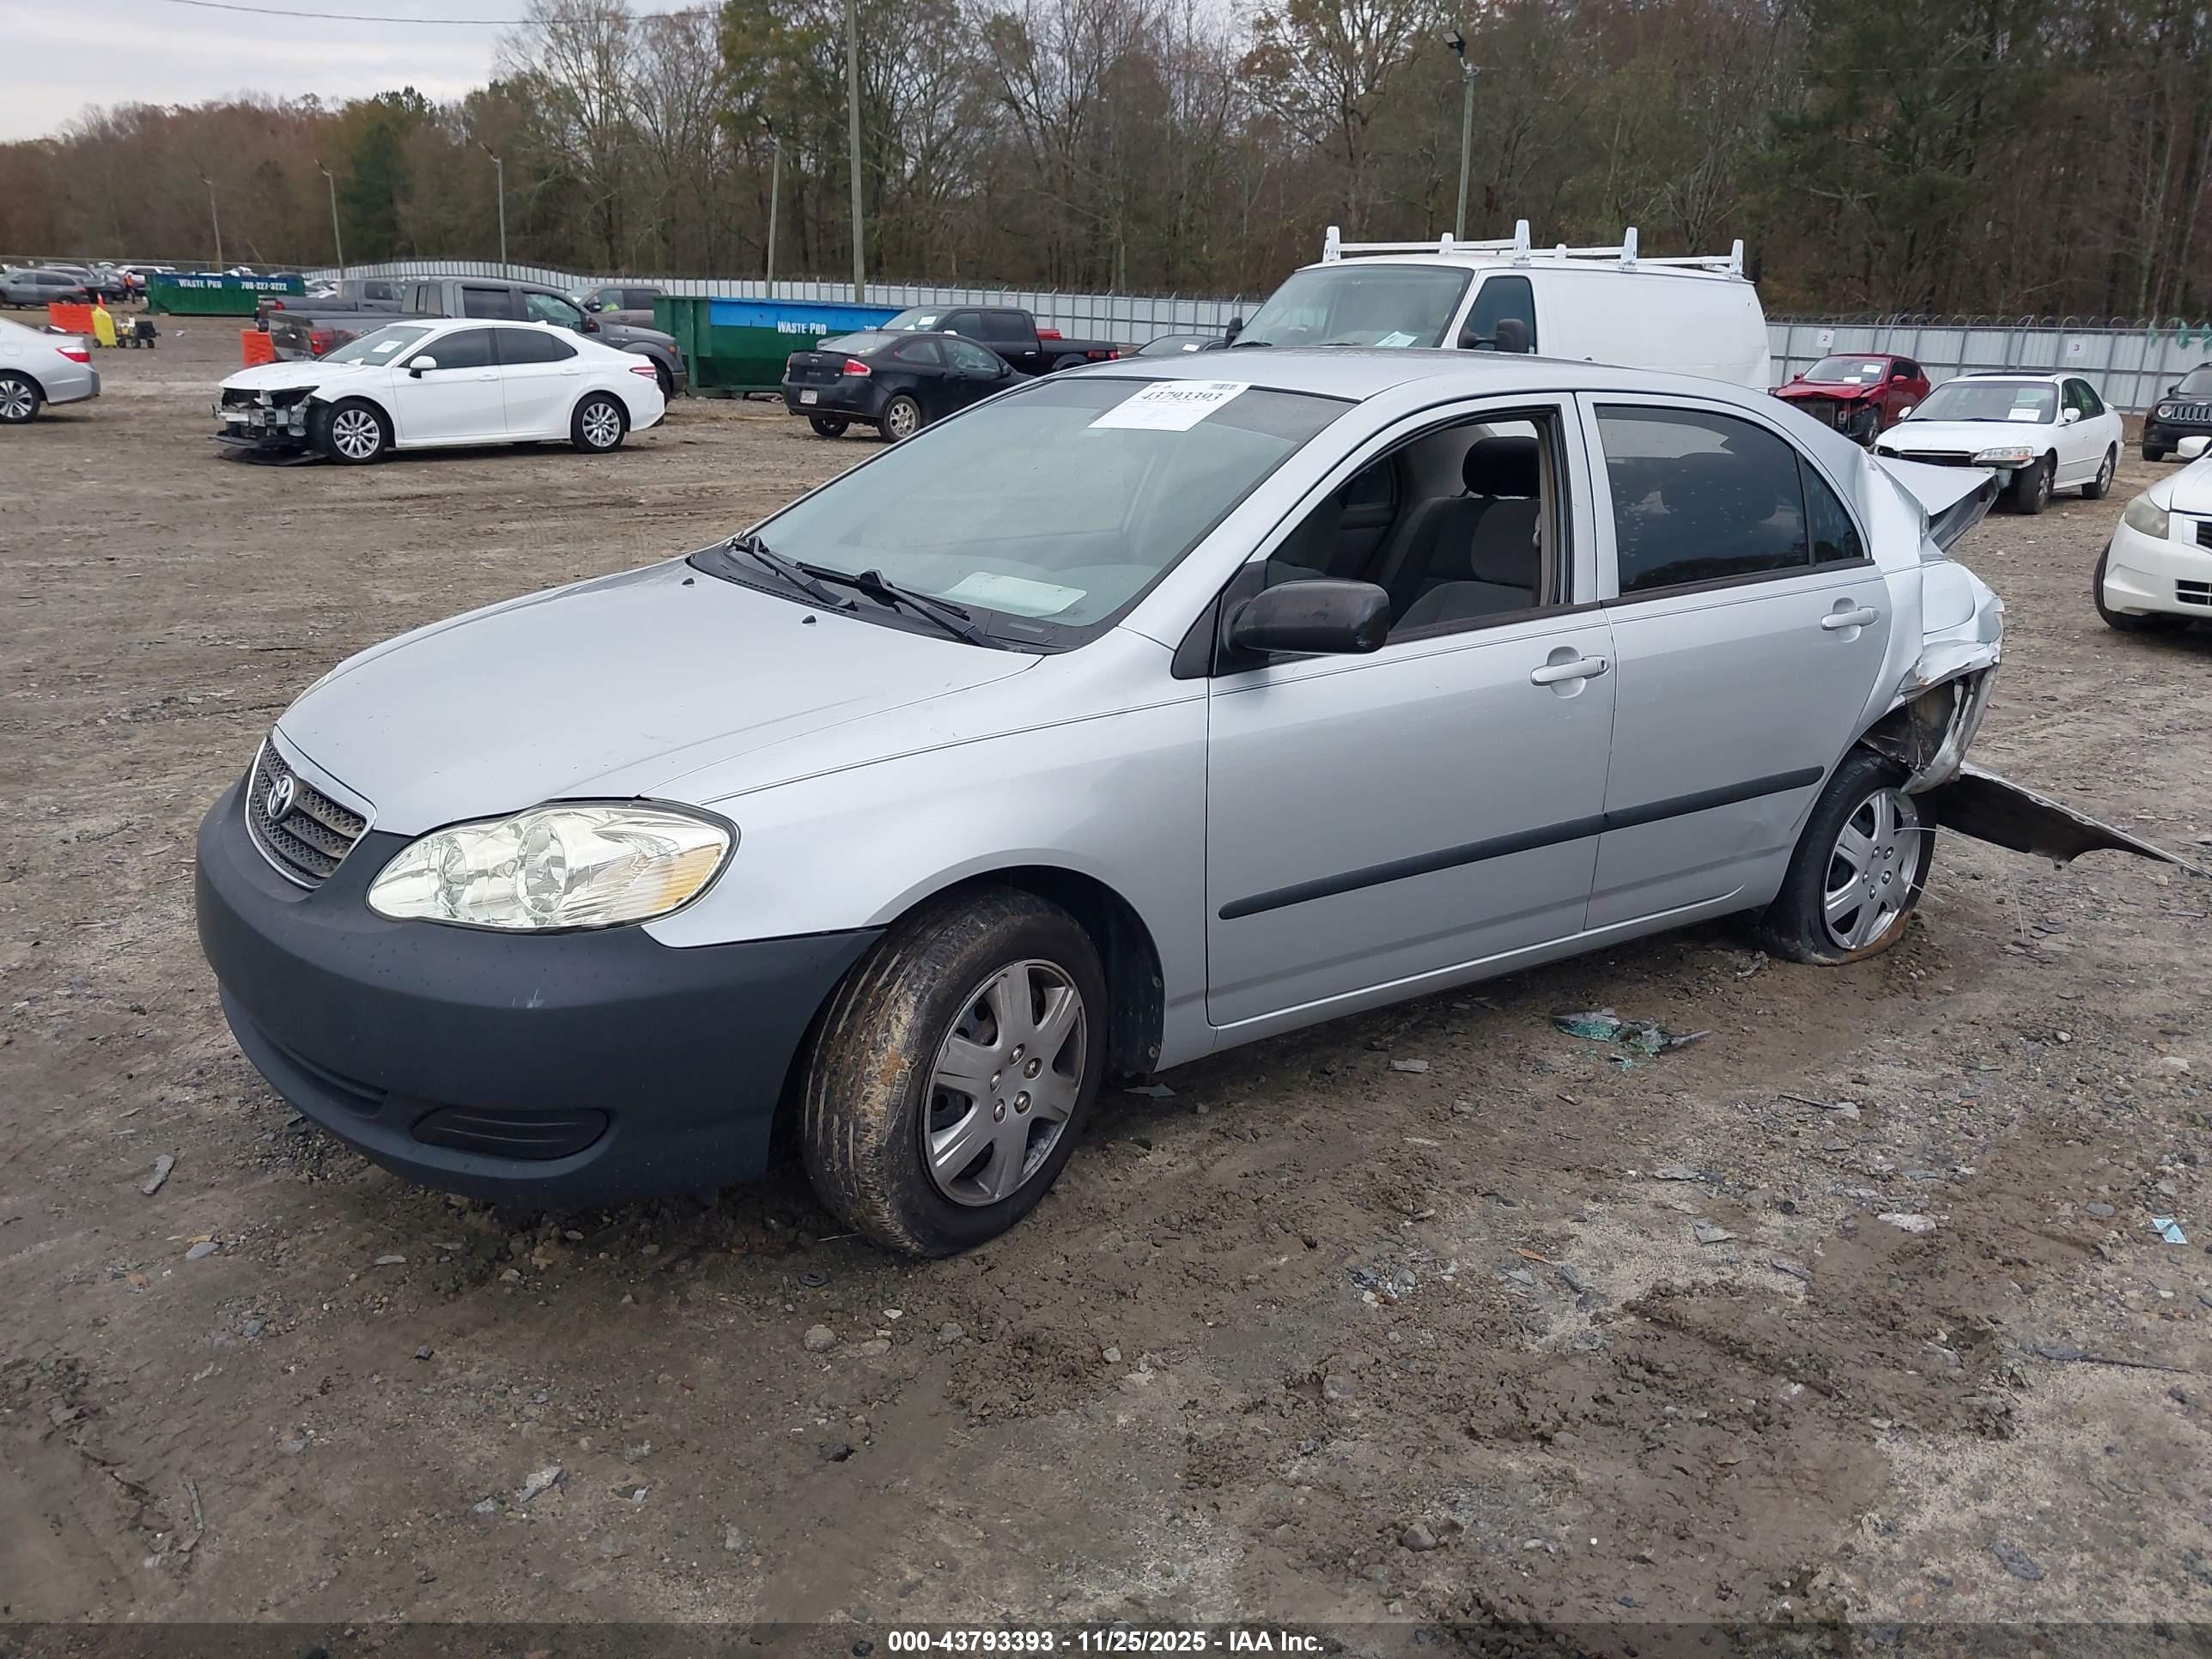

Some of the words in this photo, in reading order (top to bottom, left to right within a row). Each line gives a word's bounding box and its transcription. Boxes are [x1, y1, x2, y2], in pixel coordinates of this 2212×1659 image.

[777, 320, 807, 334] WASTE
[809, 322, 827, 336] PRO
[1141, 392, 1224, 402] 43793393
